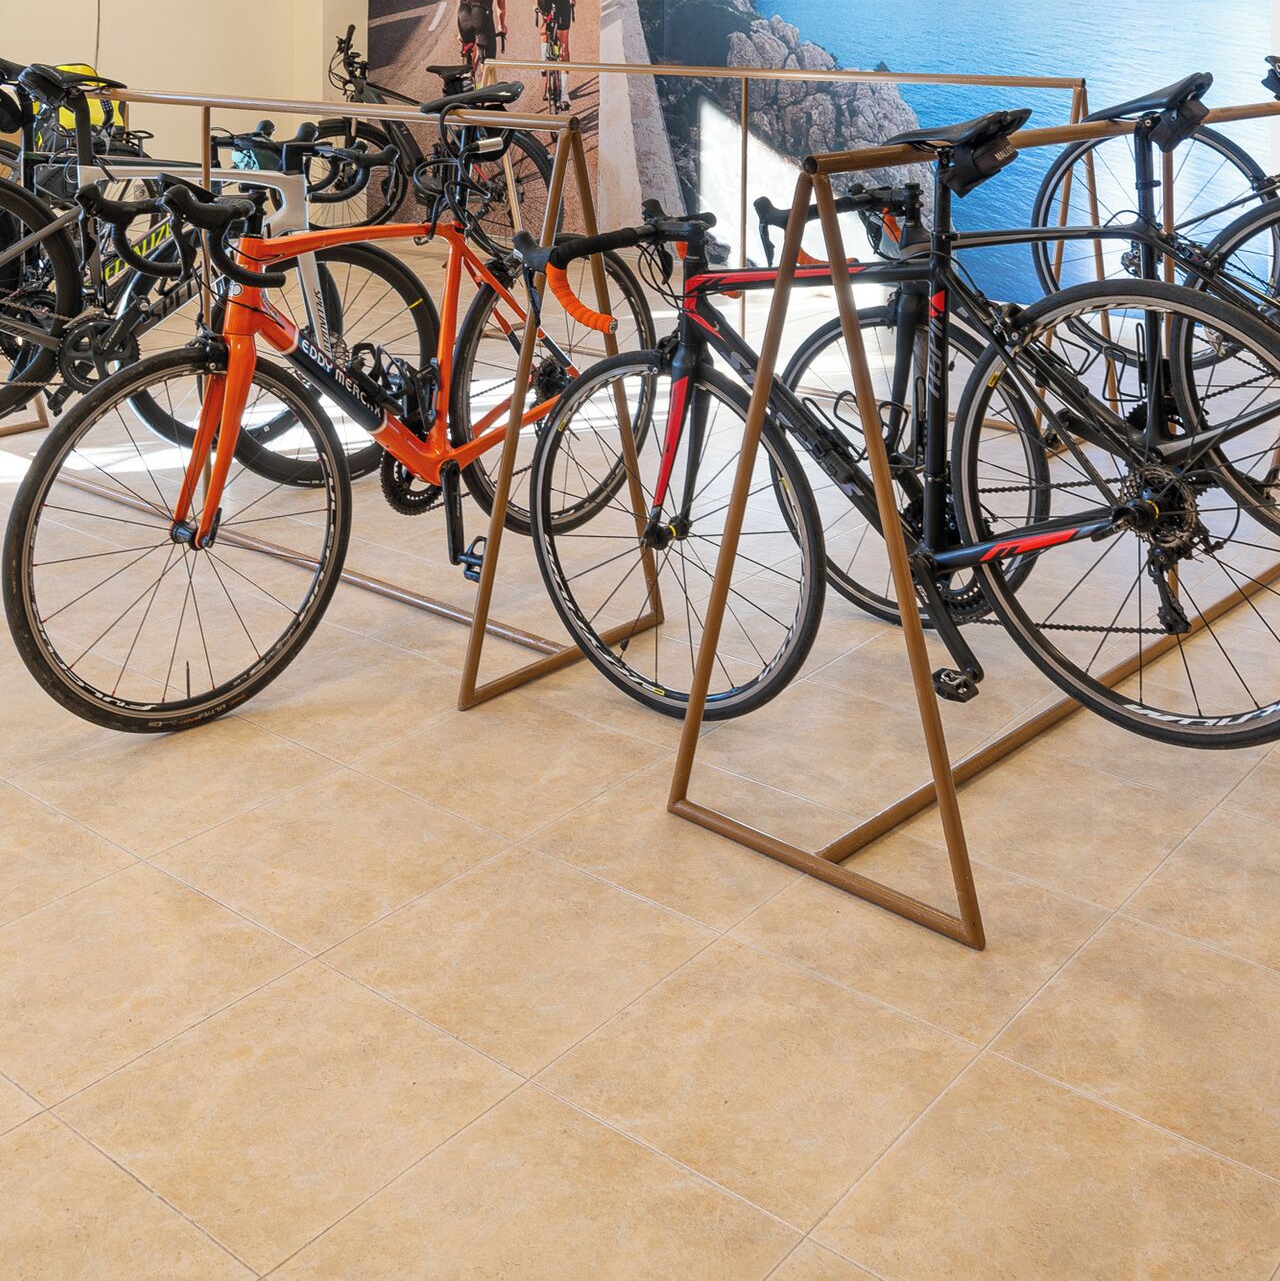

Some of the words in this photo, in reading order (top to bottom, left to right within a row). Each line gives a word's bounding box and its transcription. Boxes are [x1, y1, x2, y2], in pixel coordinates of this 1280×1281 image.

[301, 339, 333, 373] EDDY
[335, 368, 382, 418] MERCX
[31, 601, 158, 711] FULCRUM
